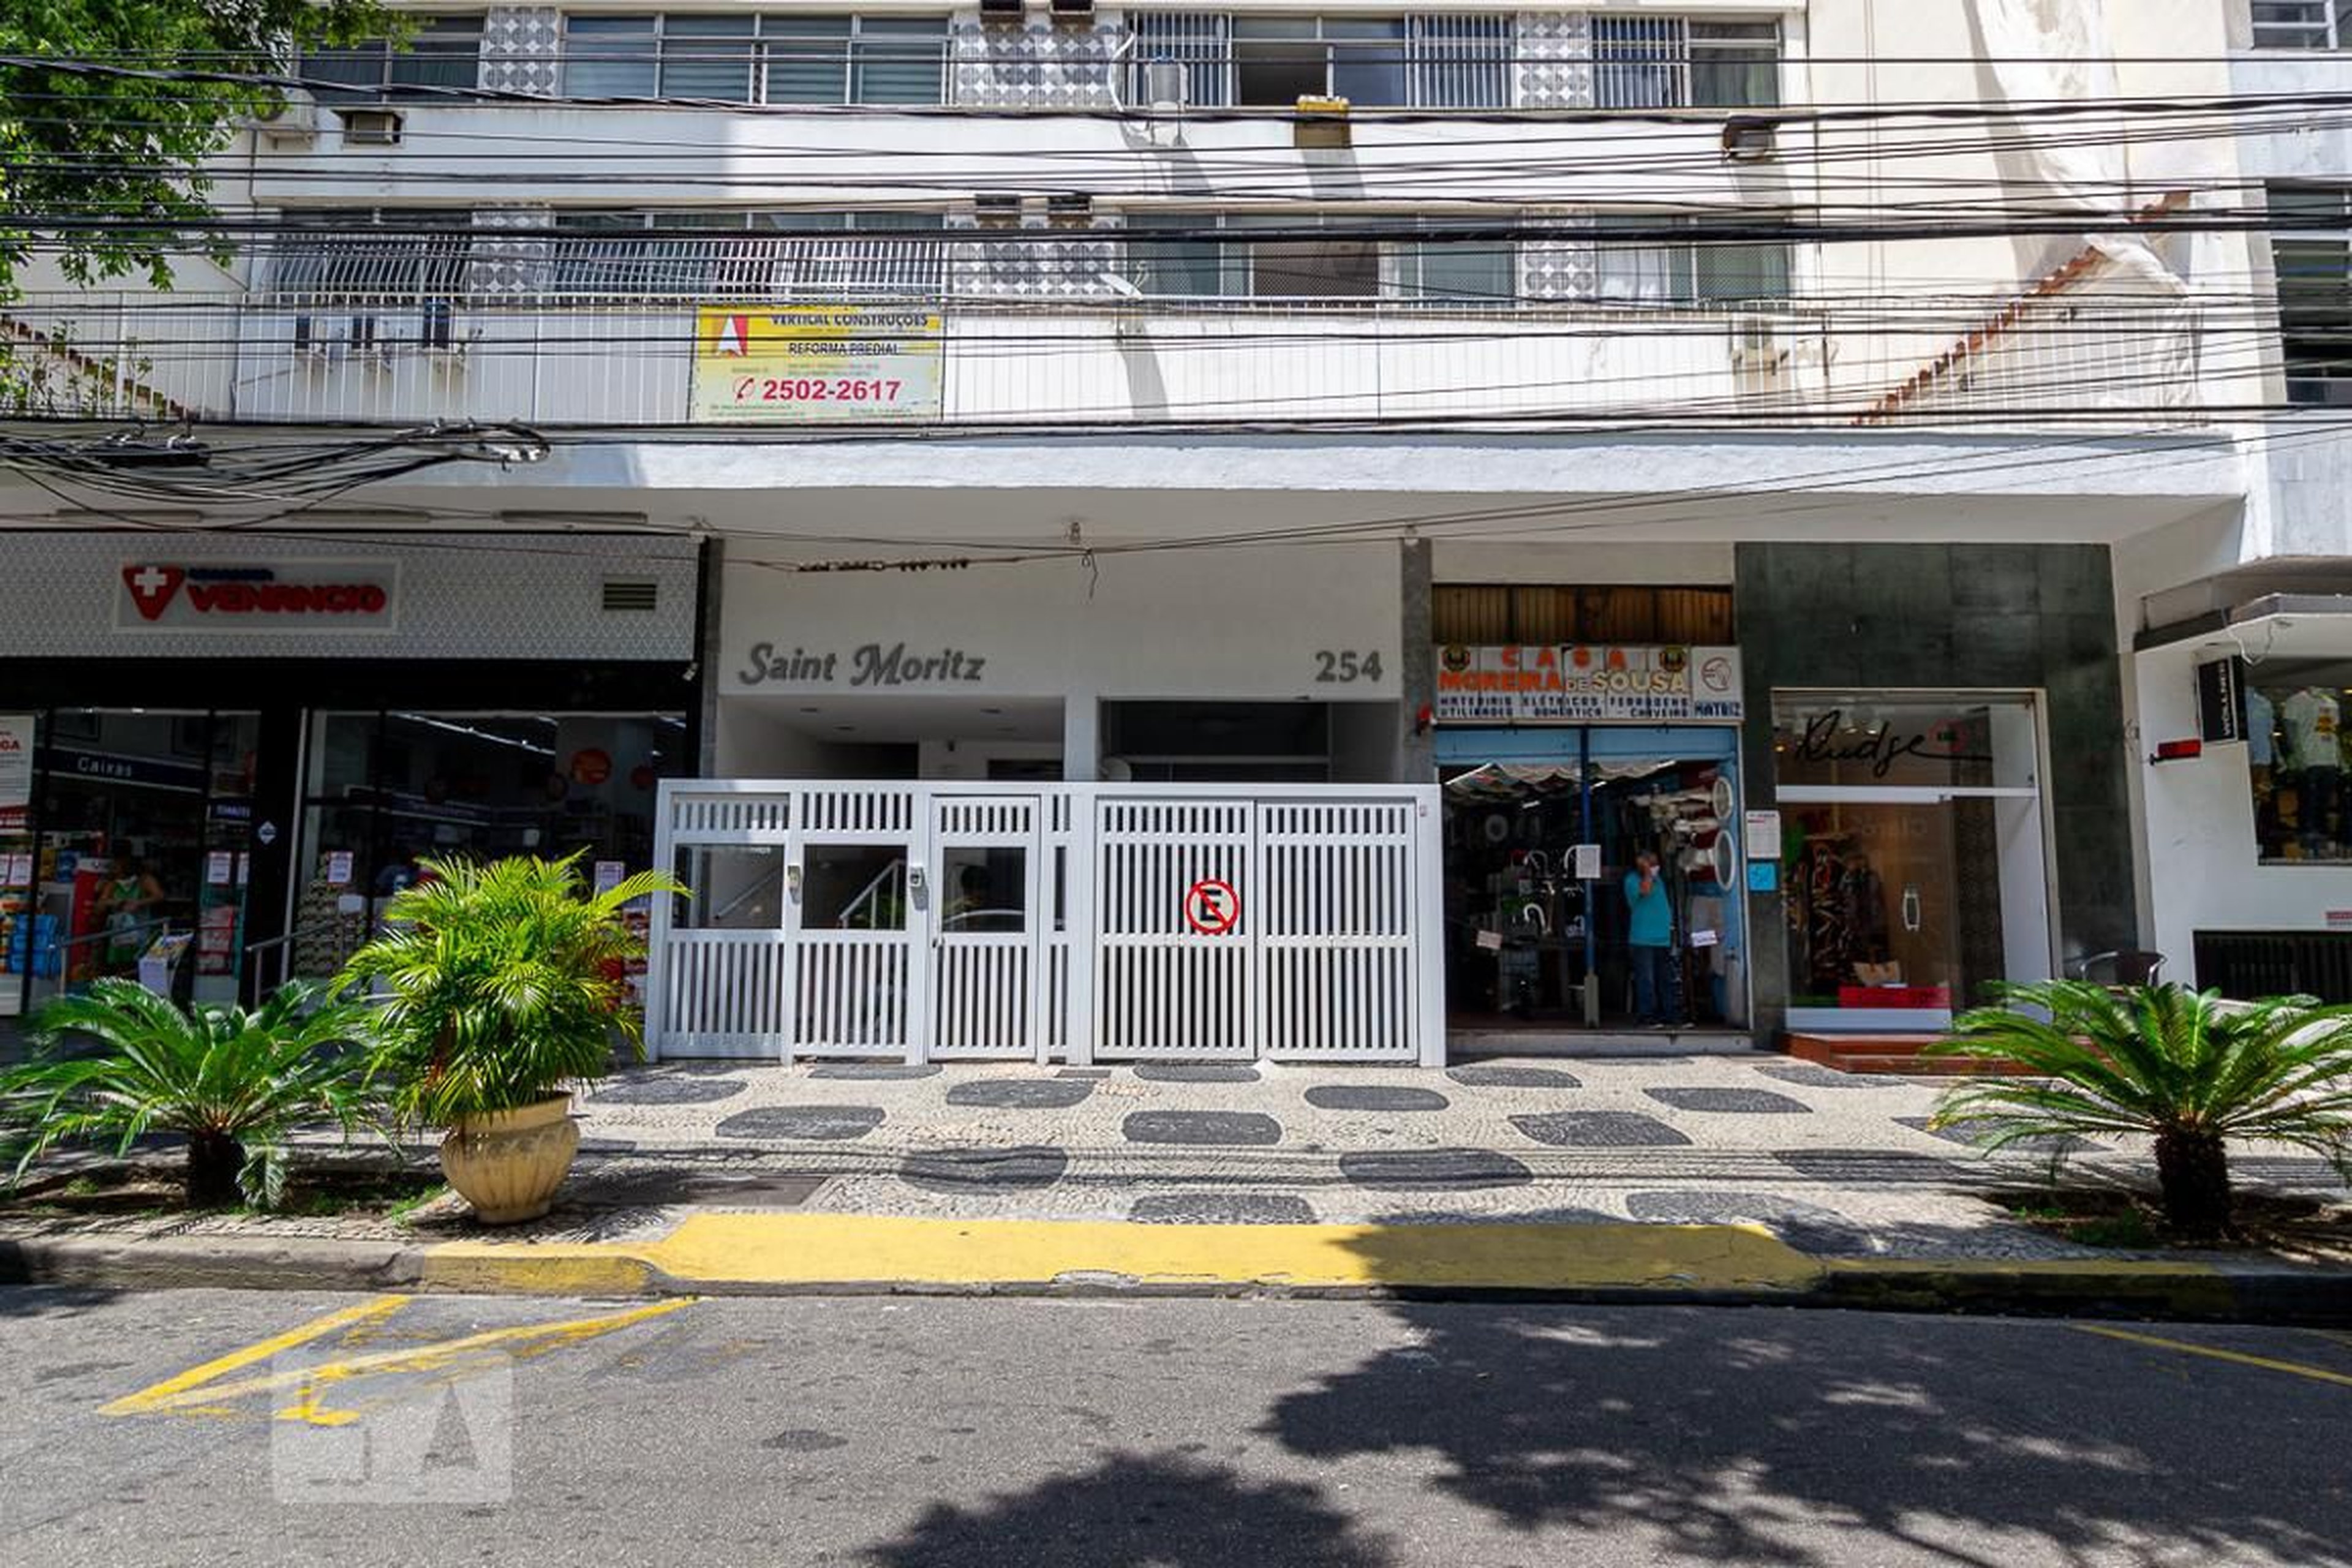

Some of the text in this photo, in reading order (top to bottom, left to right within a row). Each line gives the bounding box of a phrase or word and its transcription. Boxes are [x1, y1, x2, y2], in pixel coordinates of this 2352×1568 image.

[789, 342, 846, 354] REFORMA
[763, 379, 901, 401] 2502-2617
[739, 642, 986, 685] Saint Moritz
[1315, 650, 1383, 682] 254
[1438, 670, 1687, 692] MOREIRA DE SOUSA
[1694, 701, 1741, 717] MATRIZ
[77, 756, 132, 777] Caixas
